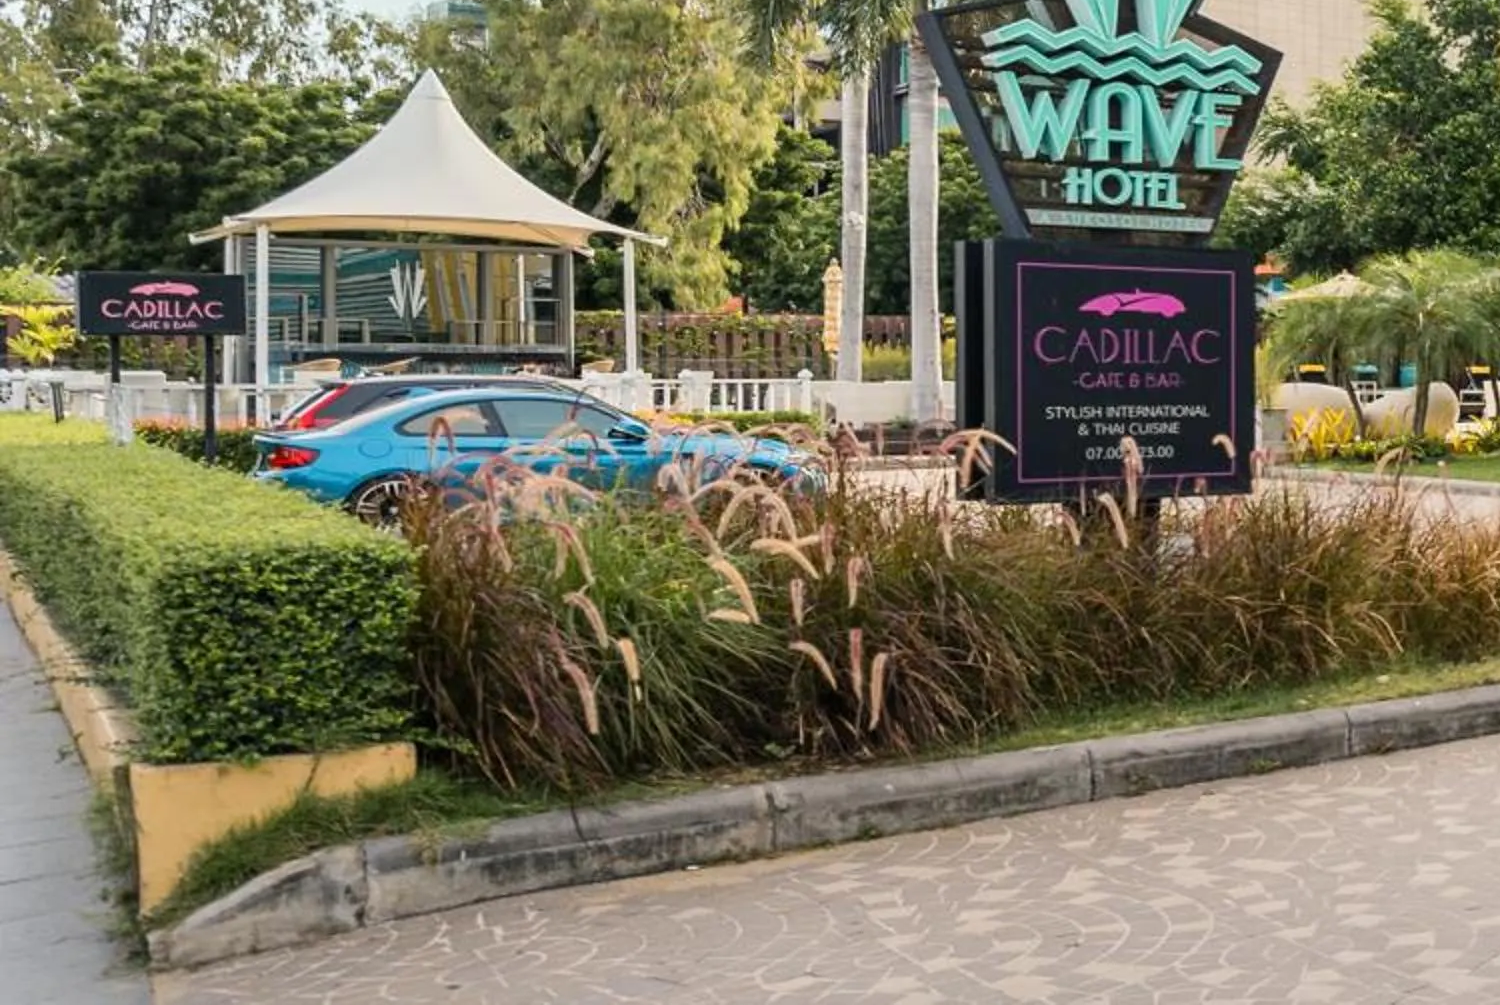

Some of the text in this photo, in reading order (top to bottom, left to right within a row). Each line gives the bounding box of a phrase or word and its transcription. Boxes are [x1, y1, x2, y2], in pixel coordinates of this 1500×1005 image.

[994, 70, 1243, 171] WAVE
[1061, 166, 1187, 211] HOTEL
[100, 298, 225, 320] CADILLAC
[1033, 325, 1222, 365] CADILLAC
[1128, 372, 1141, 388] &
[1044, 404, 1212, 420] STYLISH INTERNATIONAL
[1077, 421, 1181, 436] & THAI CUISINE
